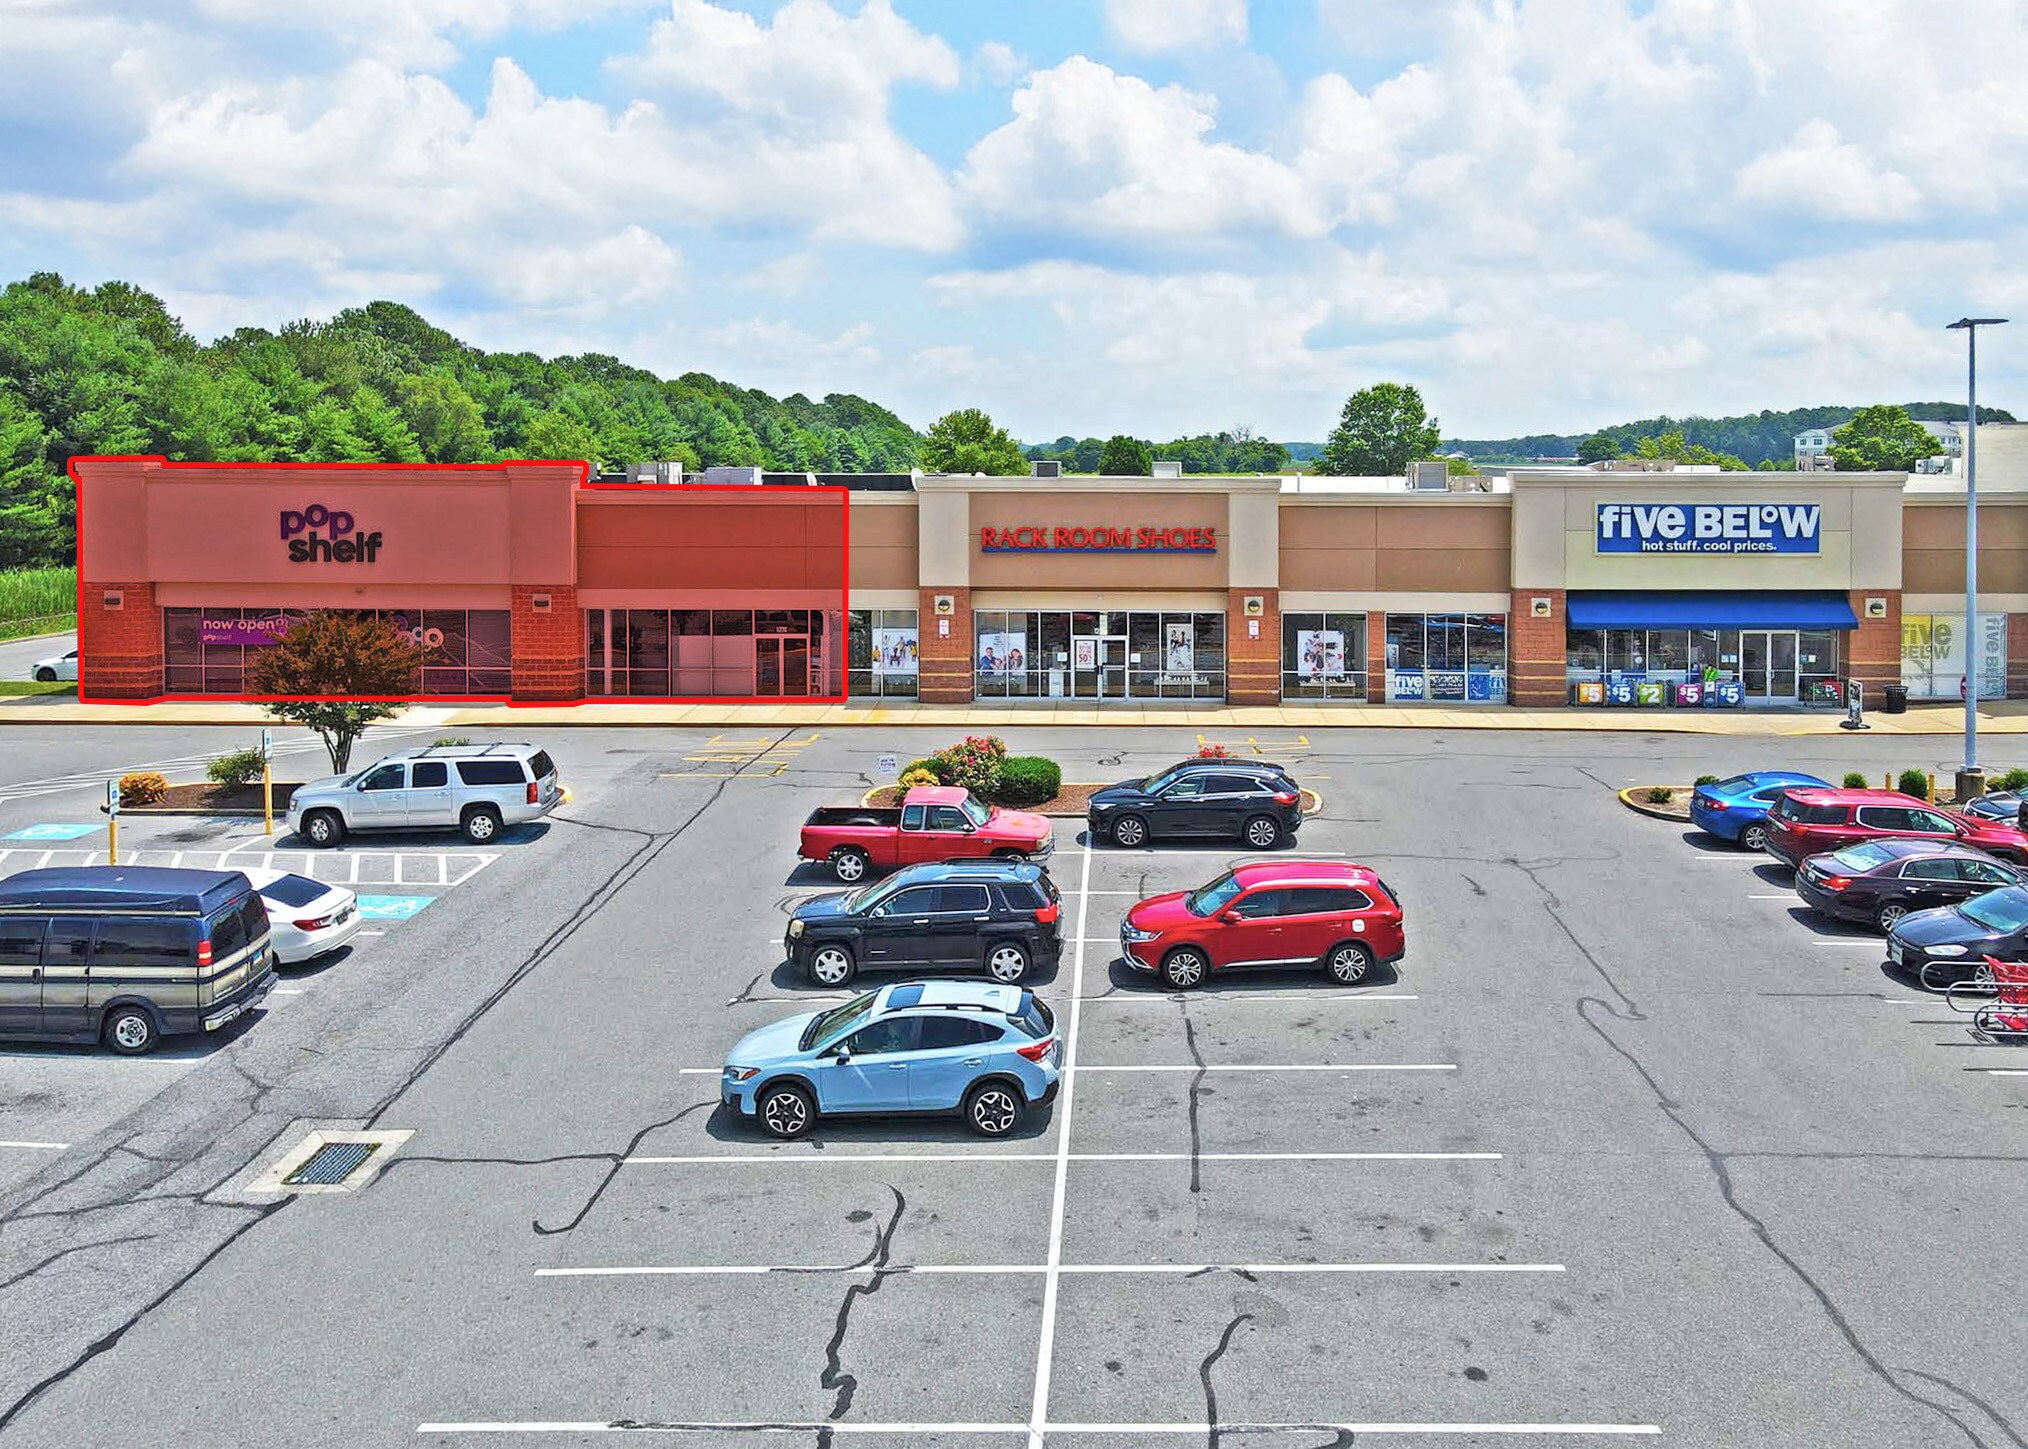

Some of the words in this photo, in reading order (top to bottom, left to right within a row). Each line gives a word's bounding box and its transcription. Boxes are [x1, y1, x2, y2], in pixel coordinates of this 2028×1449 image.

[280, 504, 355, 540] pop
[1600, 505, 1687, 539] five
[980, 527, 1048, 549] RACK
[1053, 527, 1131, 549] ROOM
[1136, 527, 1217, 549] SHOES
[1642, 540, 1664, 551] hot
[1666, 540, 1701, 551] stuff.
[1703, 540, 1731, 551] cool
[1734, 540, 1778, 553] prices.
[288, 531, 383, 563] shelf
[203, 620, 234, 630] now
[237, 620, 275, 634] open
[1395, 675, 1424, 688] five
[1582, 686, 1601, 702] $5
[1612, 686, 1631, 703] $5
[1641, 687, 1660, 704] $2
[1680, 687, 1699, 704] $5
[1720, 687, 1740, 704] $5
